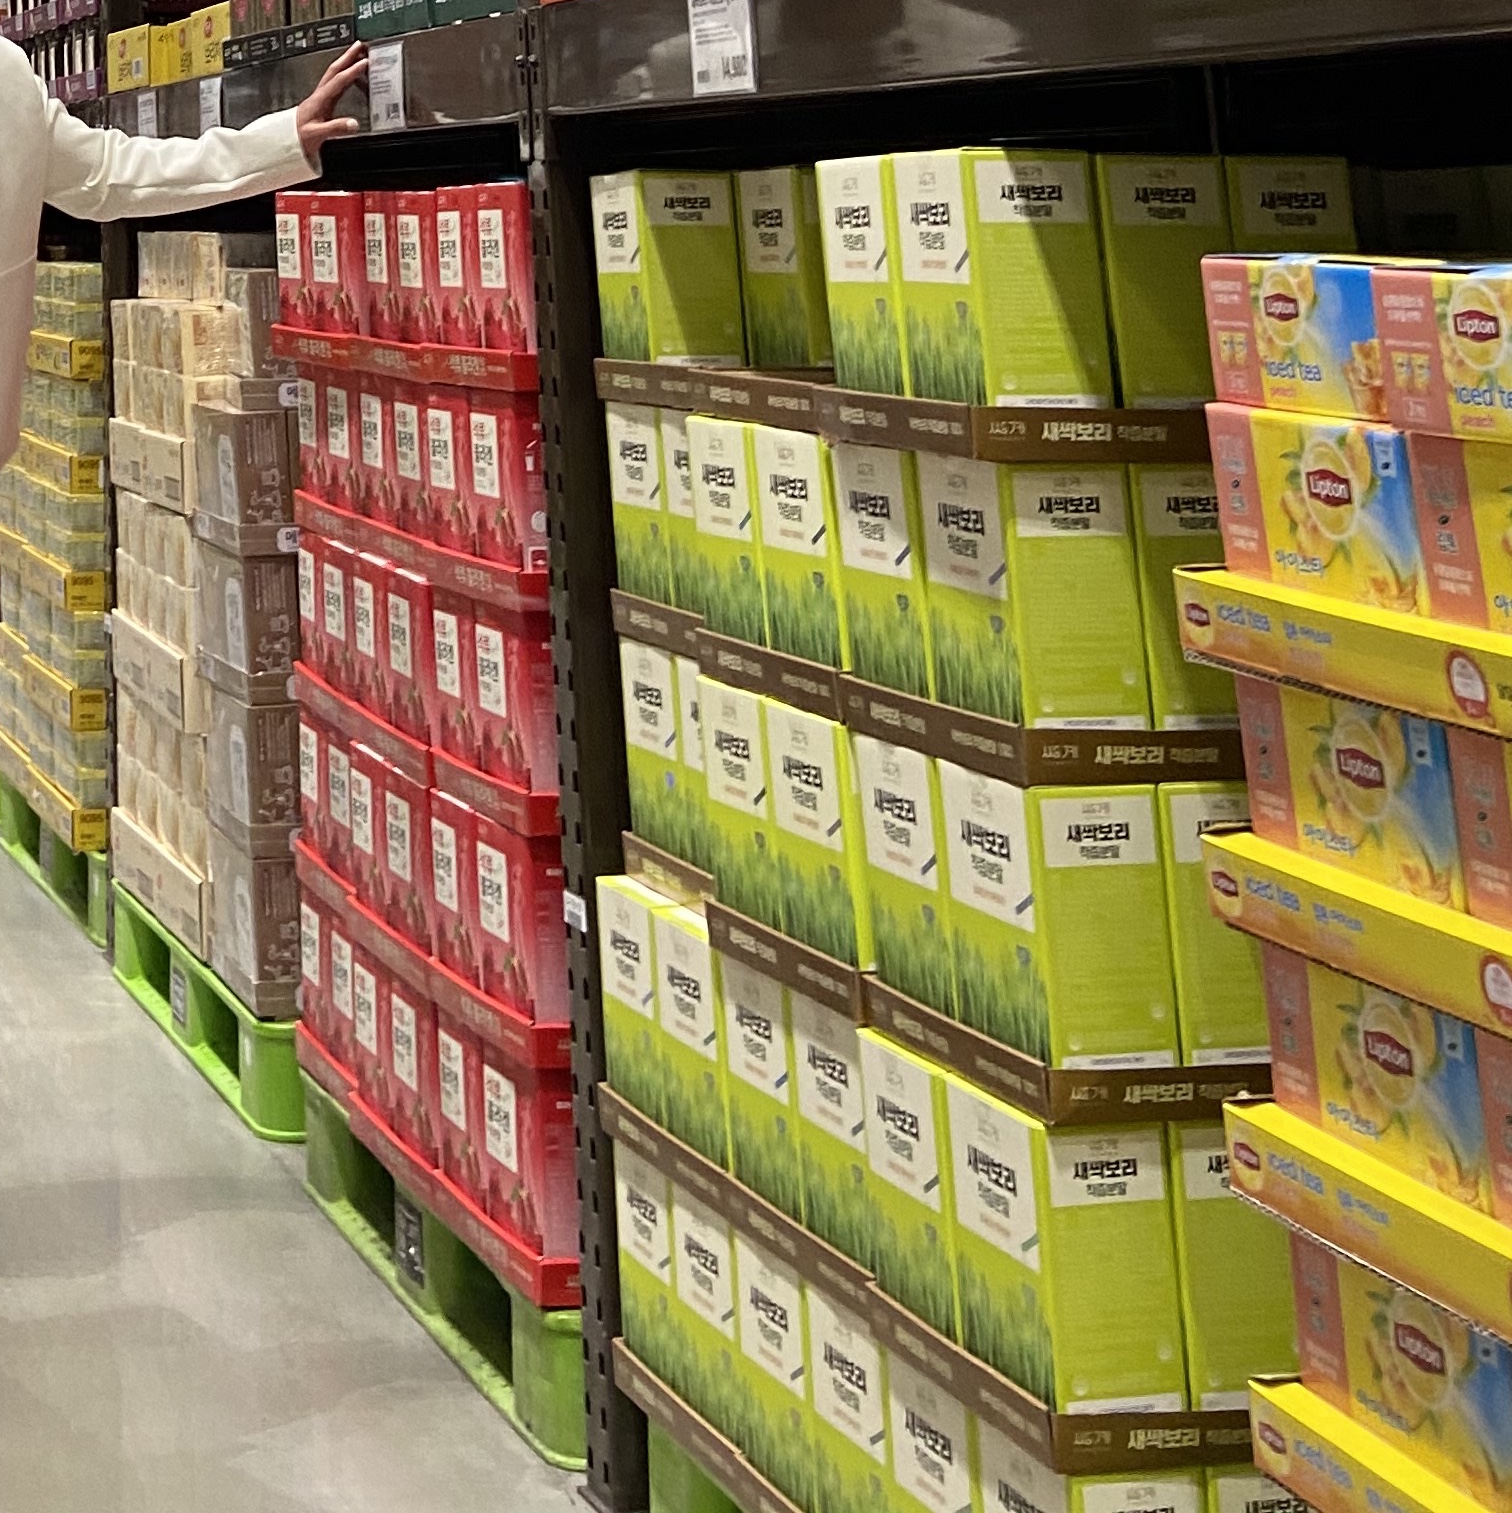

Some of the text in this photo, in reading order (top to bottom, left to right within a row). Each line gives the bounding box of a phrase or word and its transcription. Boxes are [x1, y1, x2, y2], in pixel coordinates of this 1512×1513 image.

[999, 185, 1063, 201] 새싹보리
[1134, 187, 1196, 204] 새싹보리
[1266, 298, 1298, 315] Lipton
[1457, 315, 1497, 336] Lipton
[1299, 363, 1322, 382] tea
[1456, 386, 1495, 407] iced
[1042, 421, 1112, 441] 새싹보리
[1309, 475, 1349, 500] Lipton
[1038, 496, 1101, 514] 새싹보리
[1094, 745, 1165, 765] 새싹보리
[1340, 757, 1383, 782] Lipton
[1067, 822, 1130, 842] 새싹보리
[1123, 1083, 1194, 1104] 새싹보리
[1073, 1158, 1137, 1180] 새싹보리
[1127, 1428, 1200, 1450] 새싹보리
